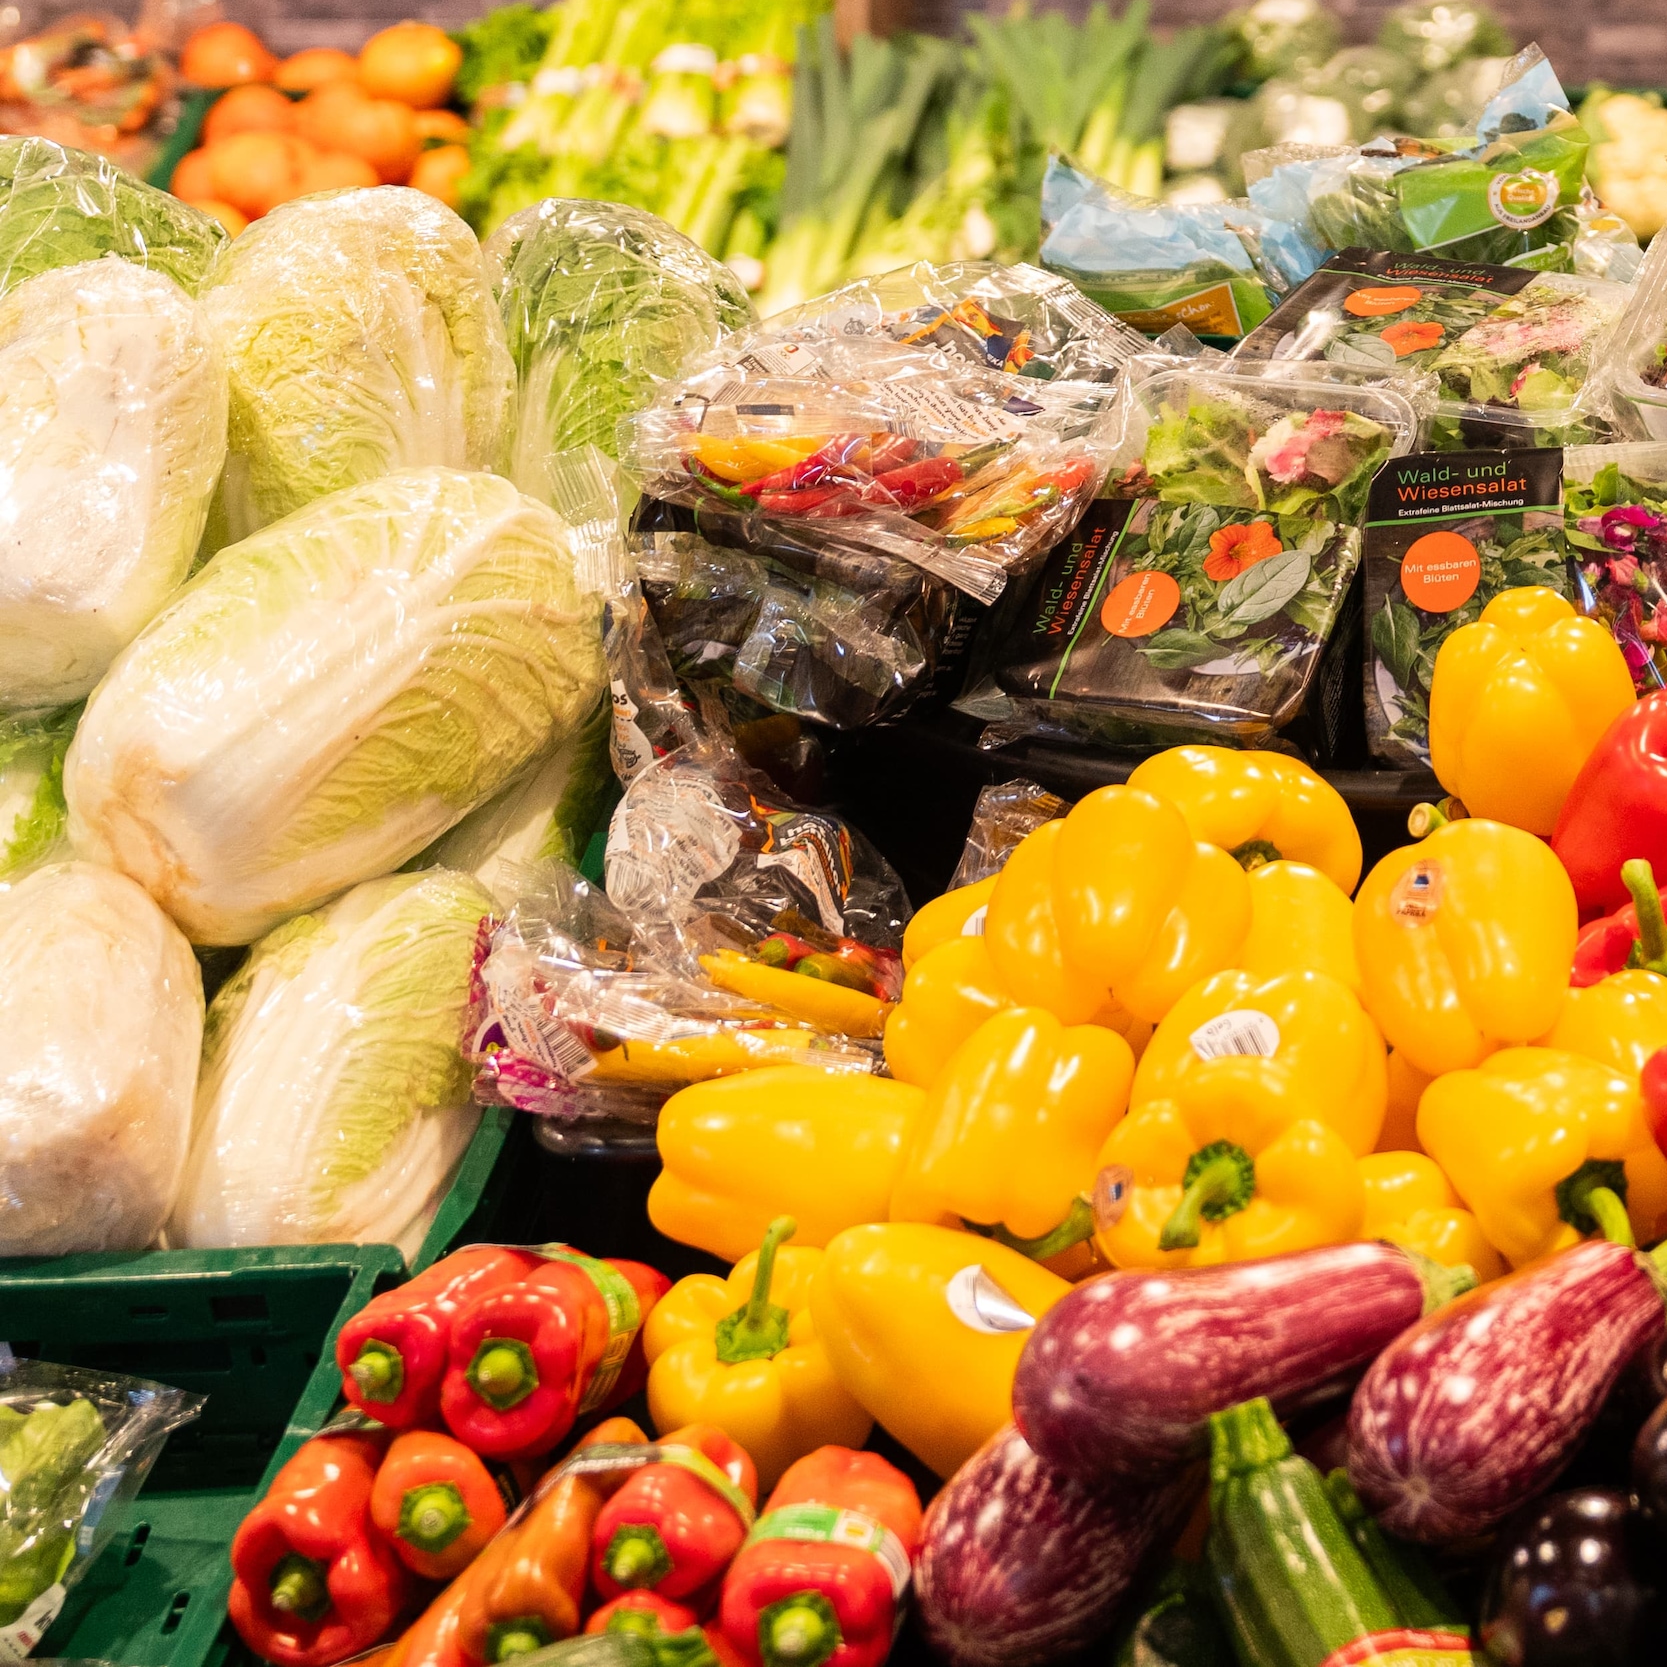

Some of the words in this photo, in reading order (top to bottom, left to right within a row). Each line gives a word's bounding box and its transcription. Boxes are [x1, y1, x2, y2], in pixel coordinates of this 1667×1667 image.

[1385, 268, 1494, 283] Wiesensalat
[1451, 267, 1485, 275] und
[1397, 467, 1459, 484] Wald-
[1467, 461, 1507, 478] und
[1397, 478, 1527, 502] Wiesensalat
[1398, 506, 1440, 517] Extrafeine
[1441, 498, 1524, 513] Blattsalat-Mischung
[1404, 563, 1424, 574] Mit
[1426, 559, 1476, 572] essbaren
[1047, 527, 1106, 634] Wiesensalat
[1423, 572, 1459, 584] Blüten
[1033, 581, 1063, 633] Wald-
[1062, 543, 1083, 575] und
